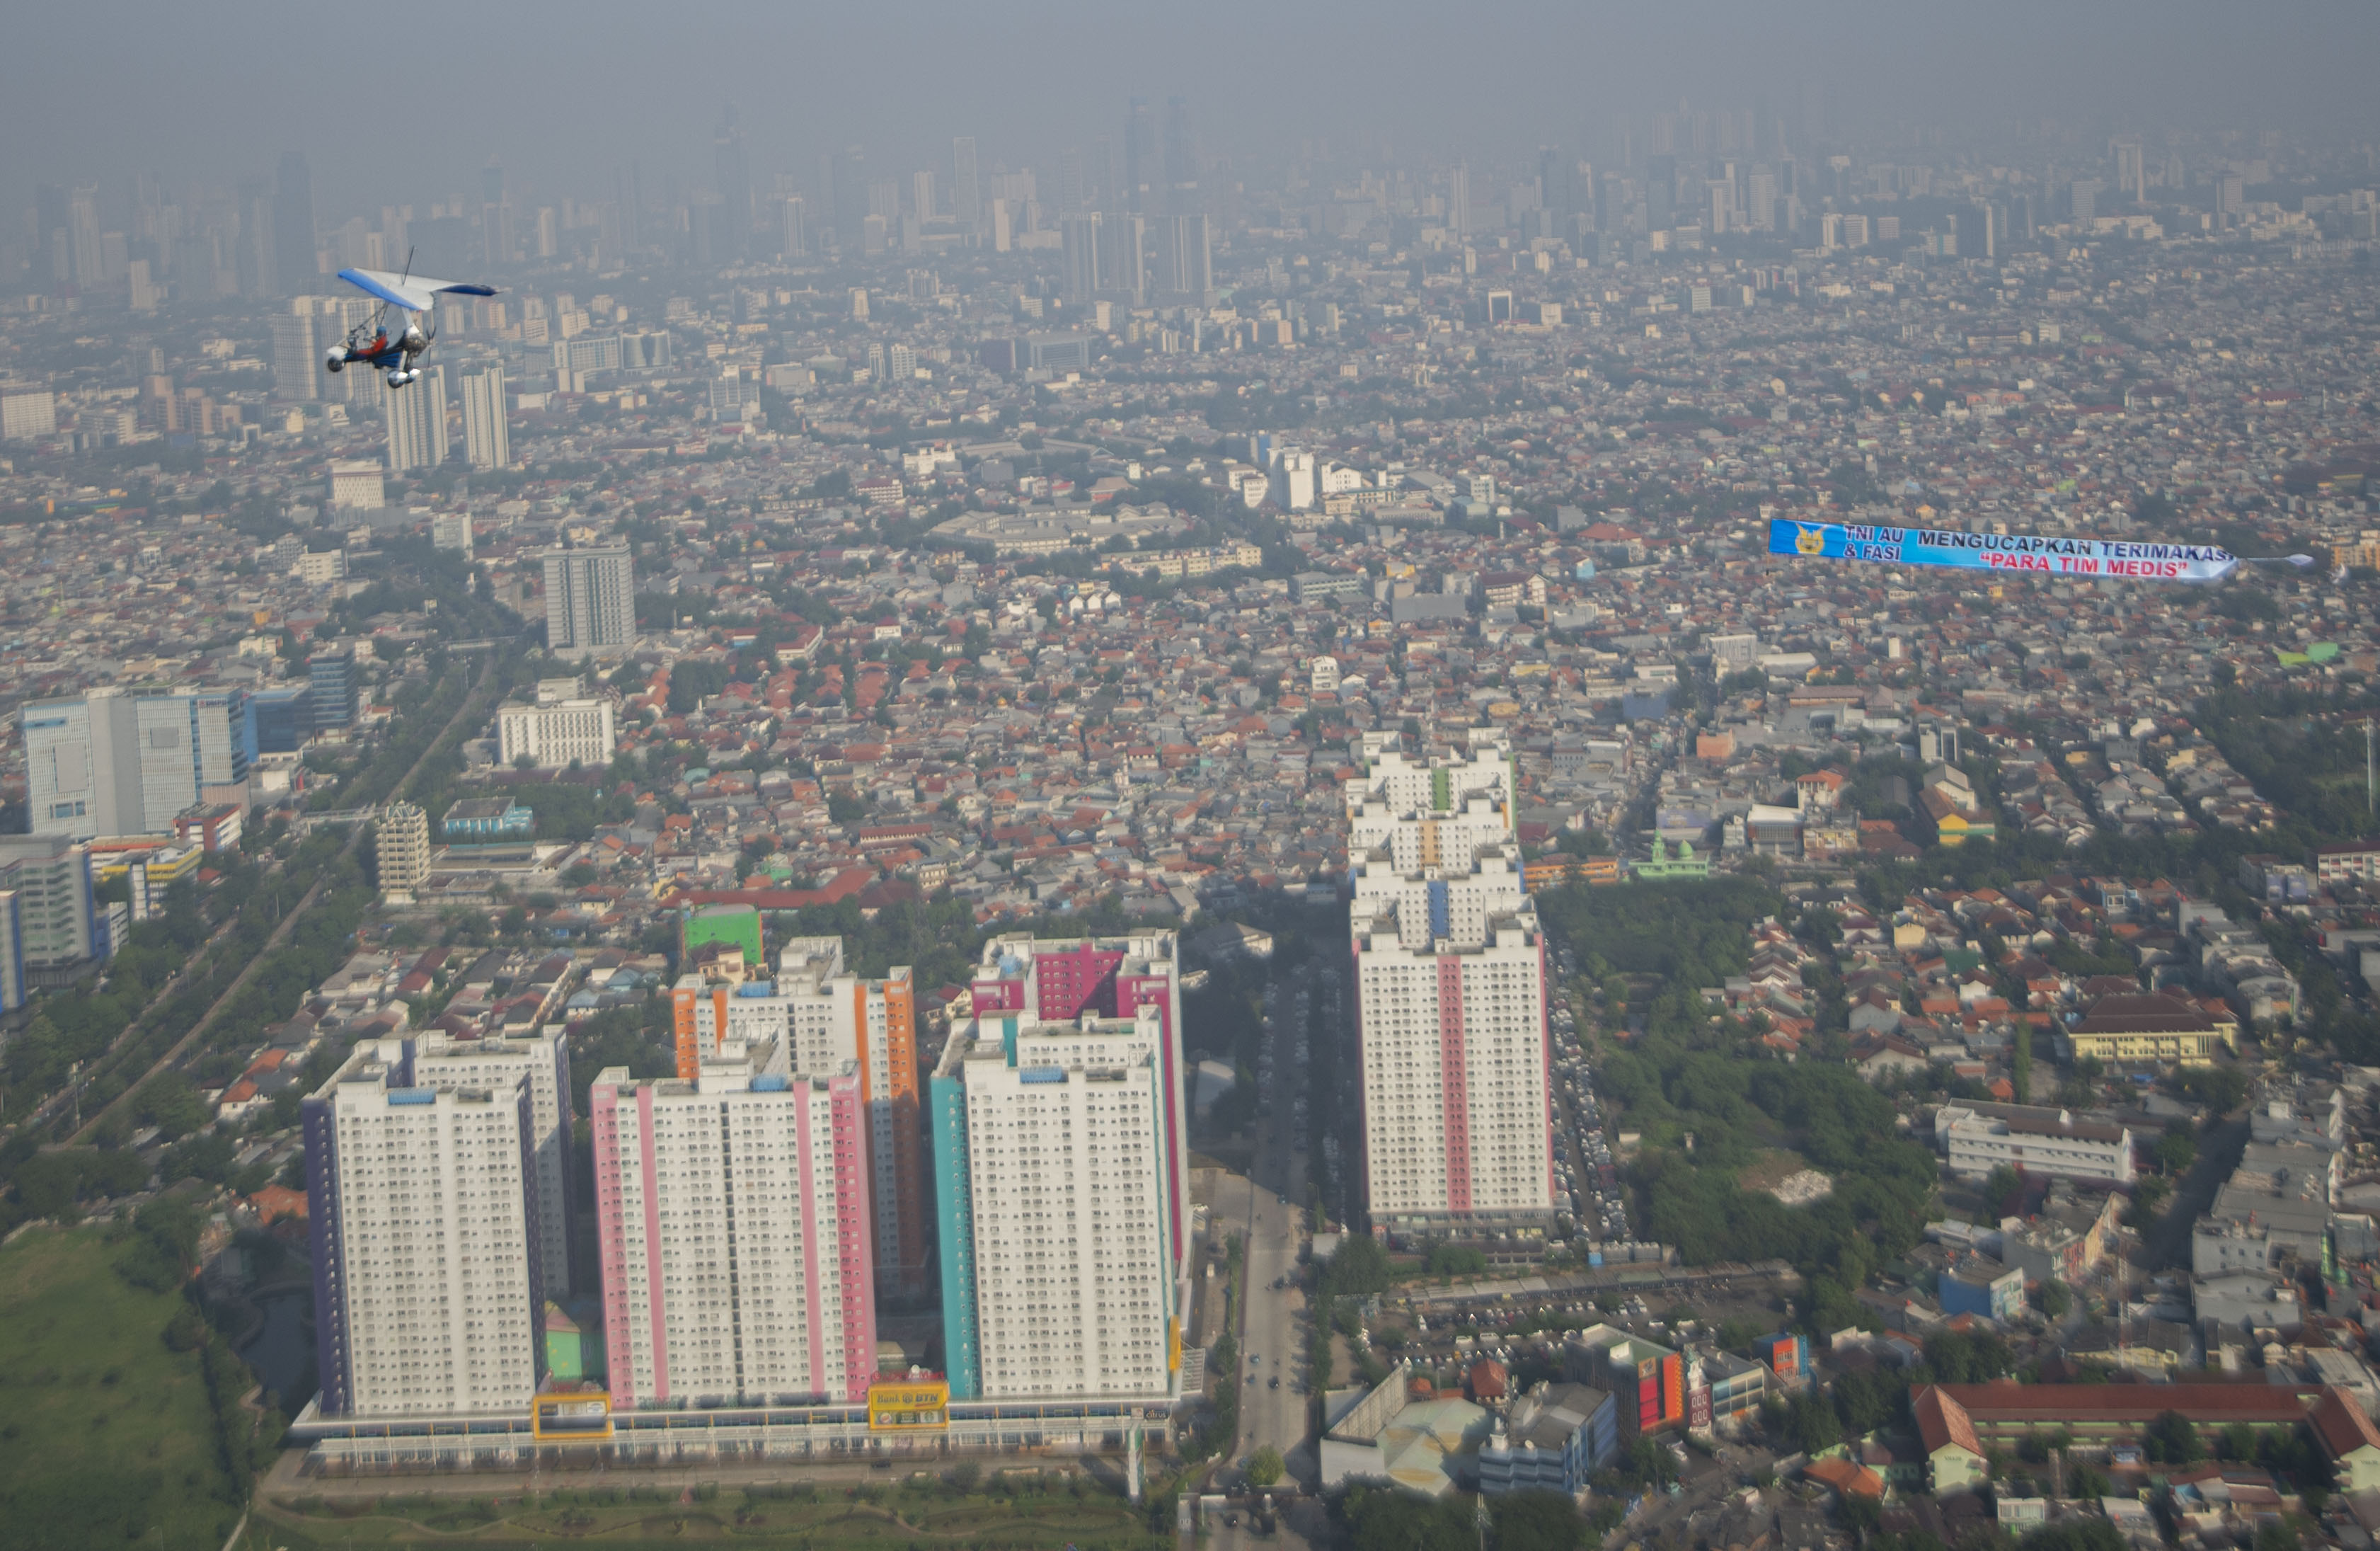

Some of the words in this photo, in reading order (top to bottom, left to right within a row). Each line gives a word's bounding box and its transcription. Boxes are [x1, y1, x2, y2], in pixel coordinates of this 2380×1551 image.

[1845, 526, 1873, 541] TNI
[1879, 528, 1903, 543] AU
[1918, 532, 2091, 555] MENGUCAPKAN
[1844, 544, 1856, 558] &
[1863, 546, 1901, 561] FASI
[2059, 557, 2098, 573] TIM
